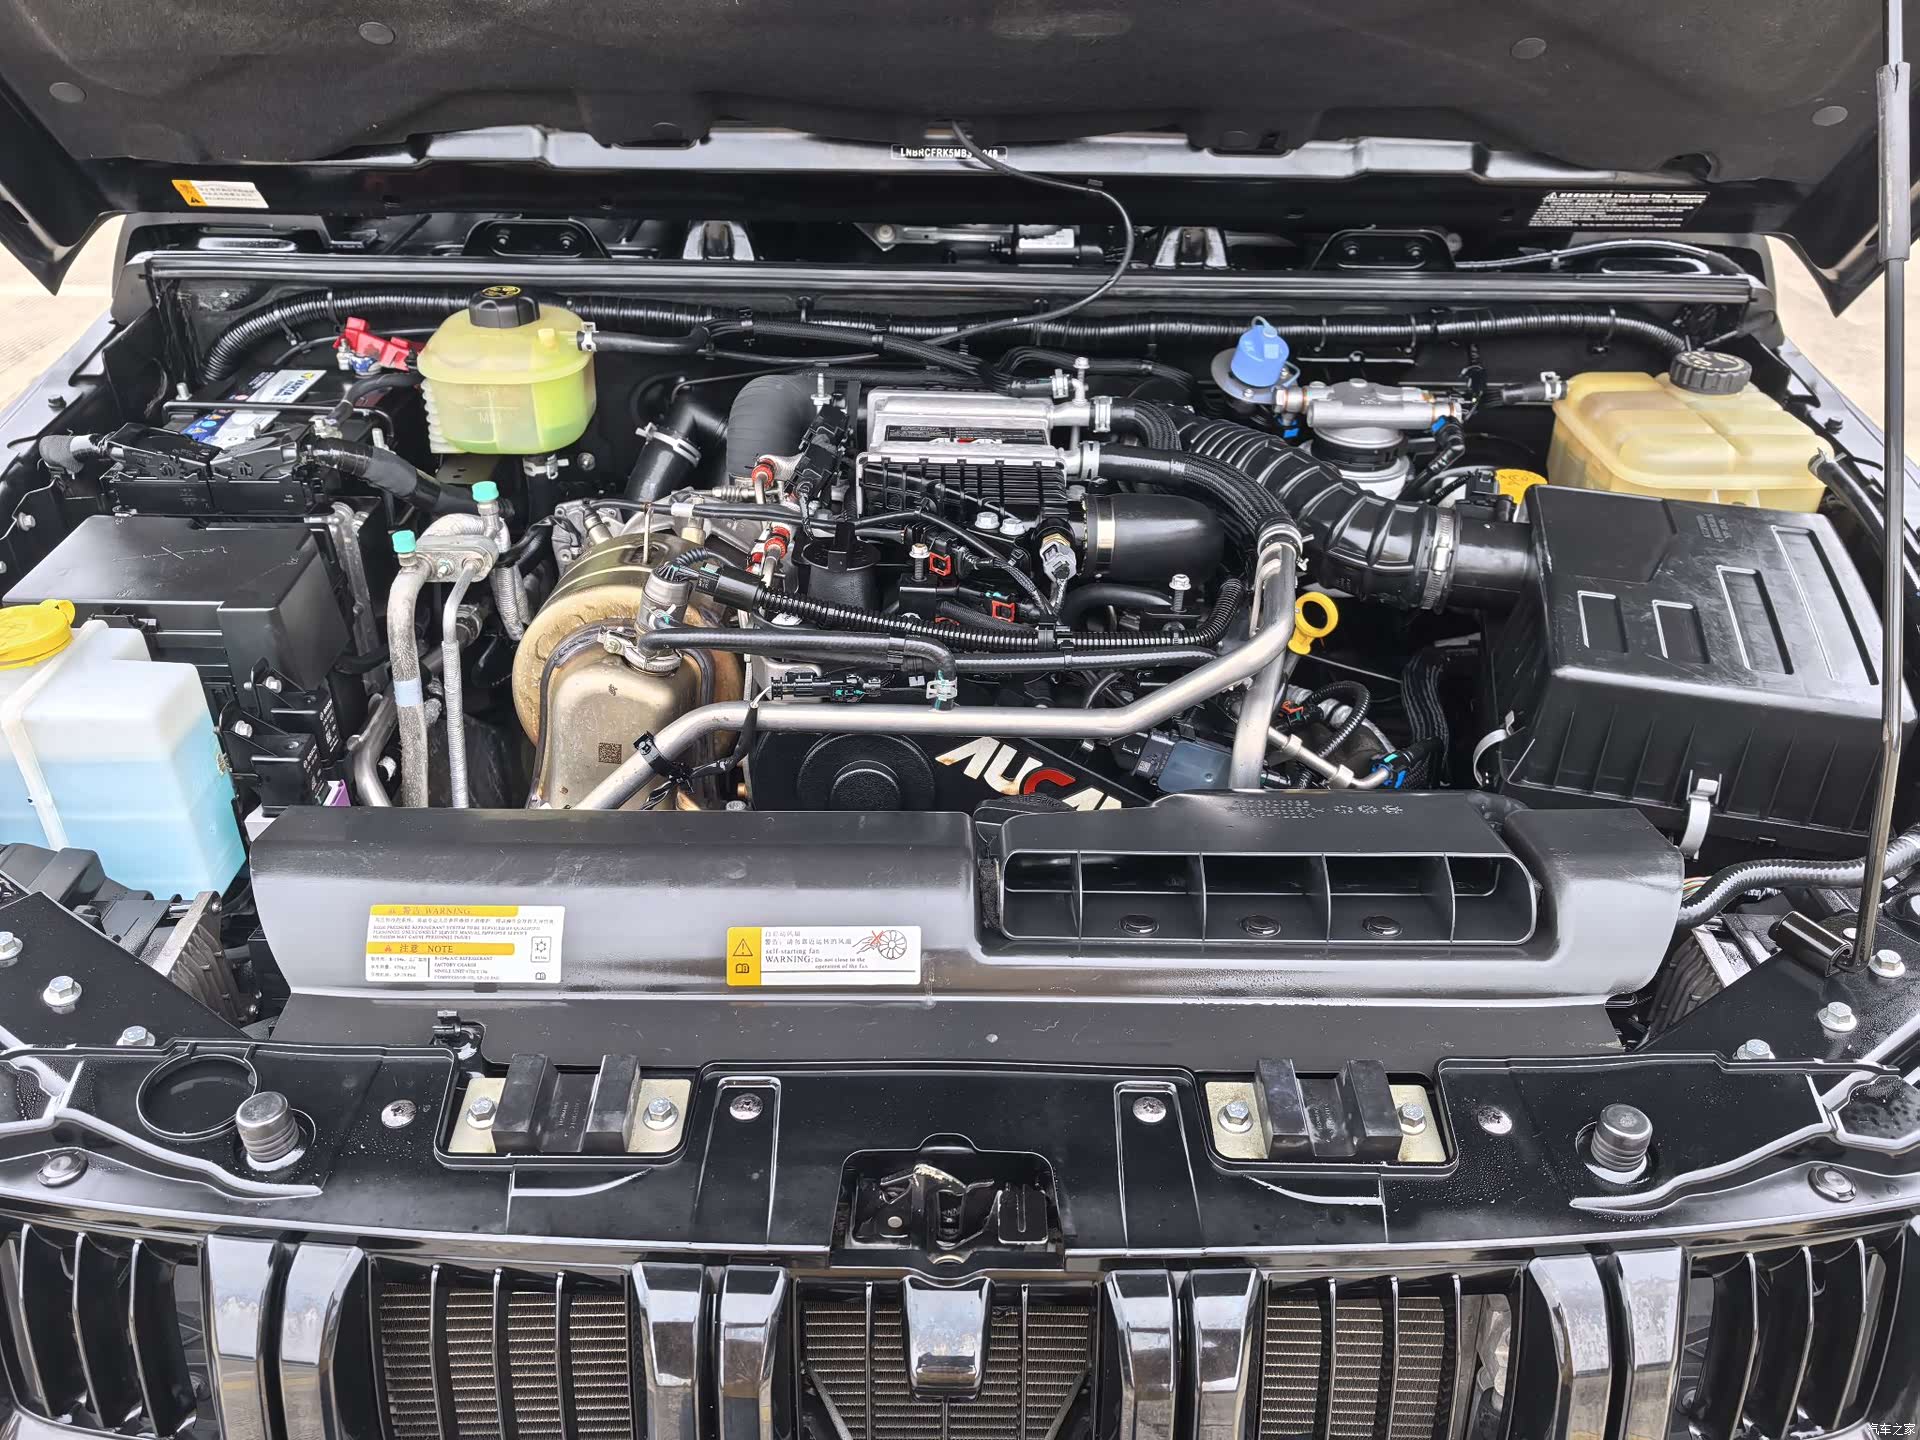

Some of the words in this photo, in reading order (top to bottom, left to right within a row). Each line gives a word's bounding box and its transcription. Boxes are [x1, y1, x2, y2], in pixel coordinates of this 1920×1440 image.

[425, 907, 471, 915] WARNING
[400, 944, 418, 953] 注意
[427, 945, 453, 953] NOTE
[765, 947, 807, 955] self-starting
